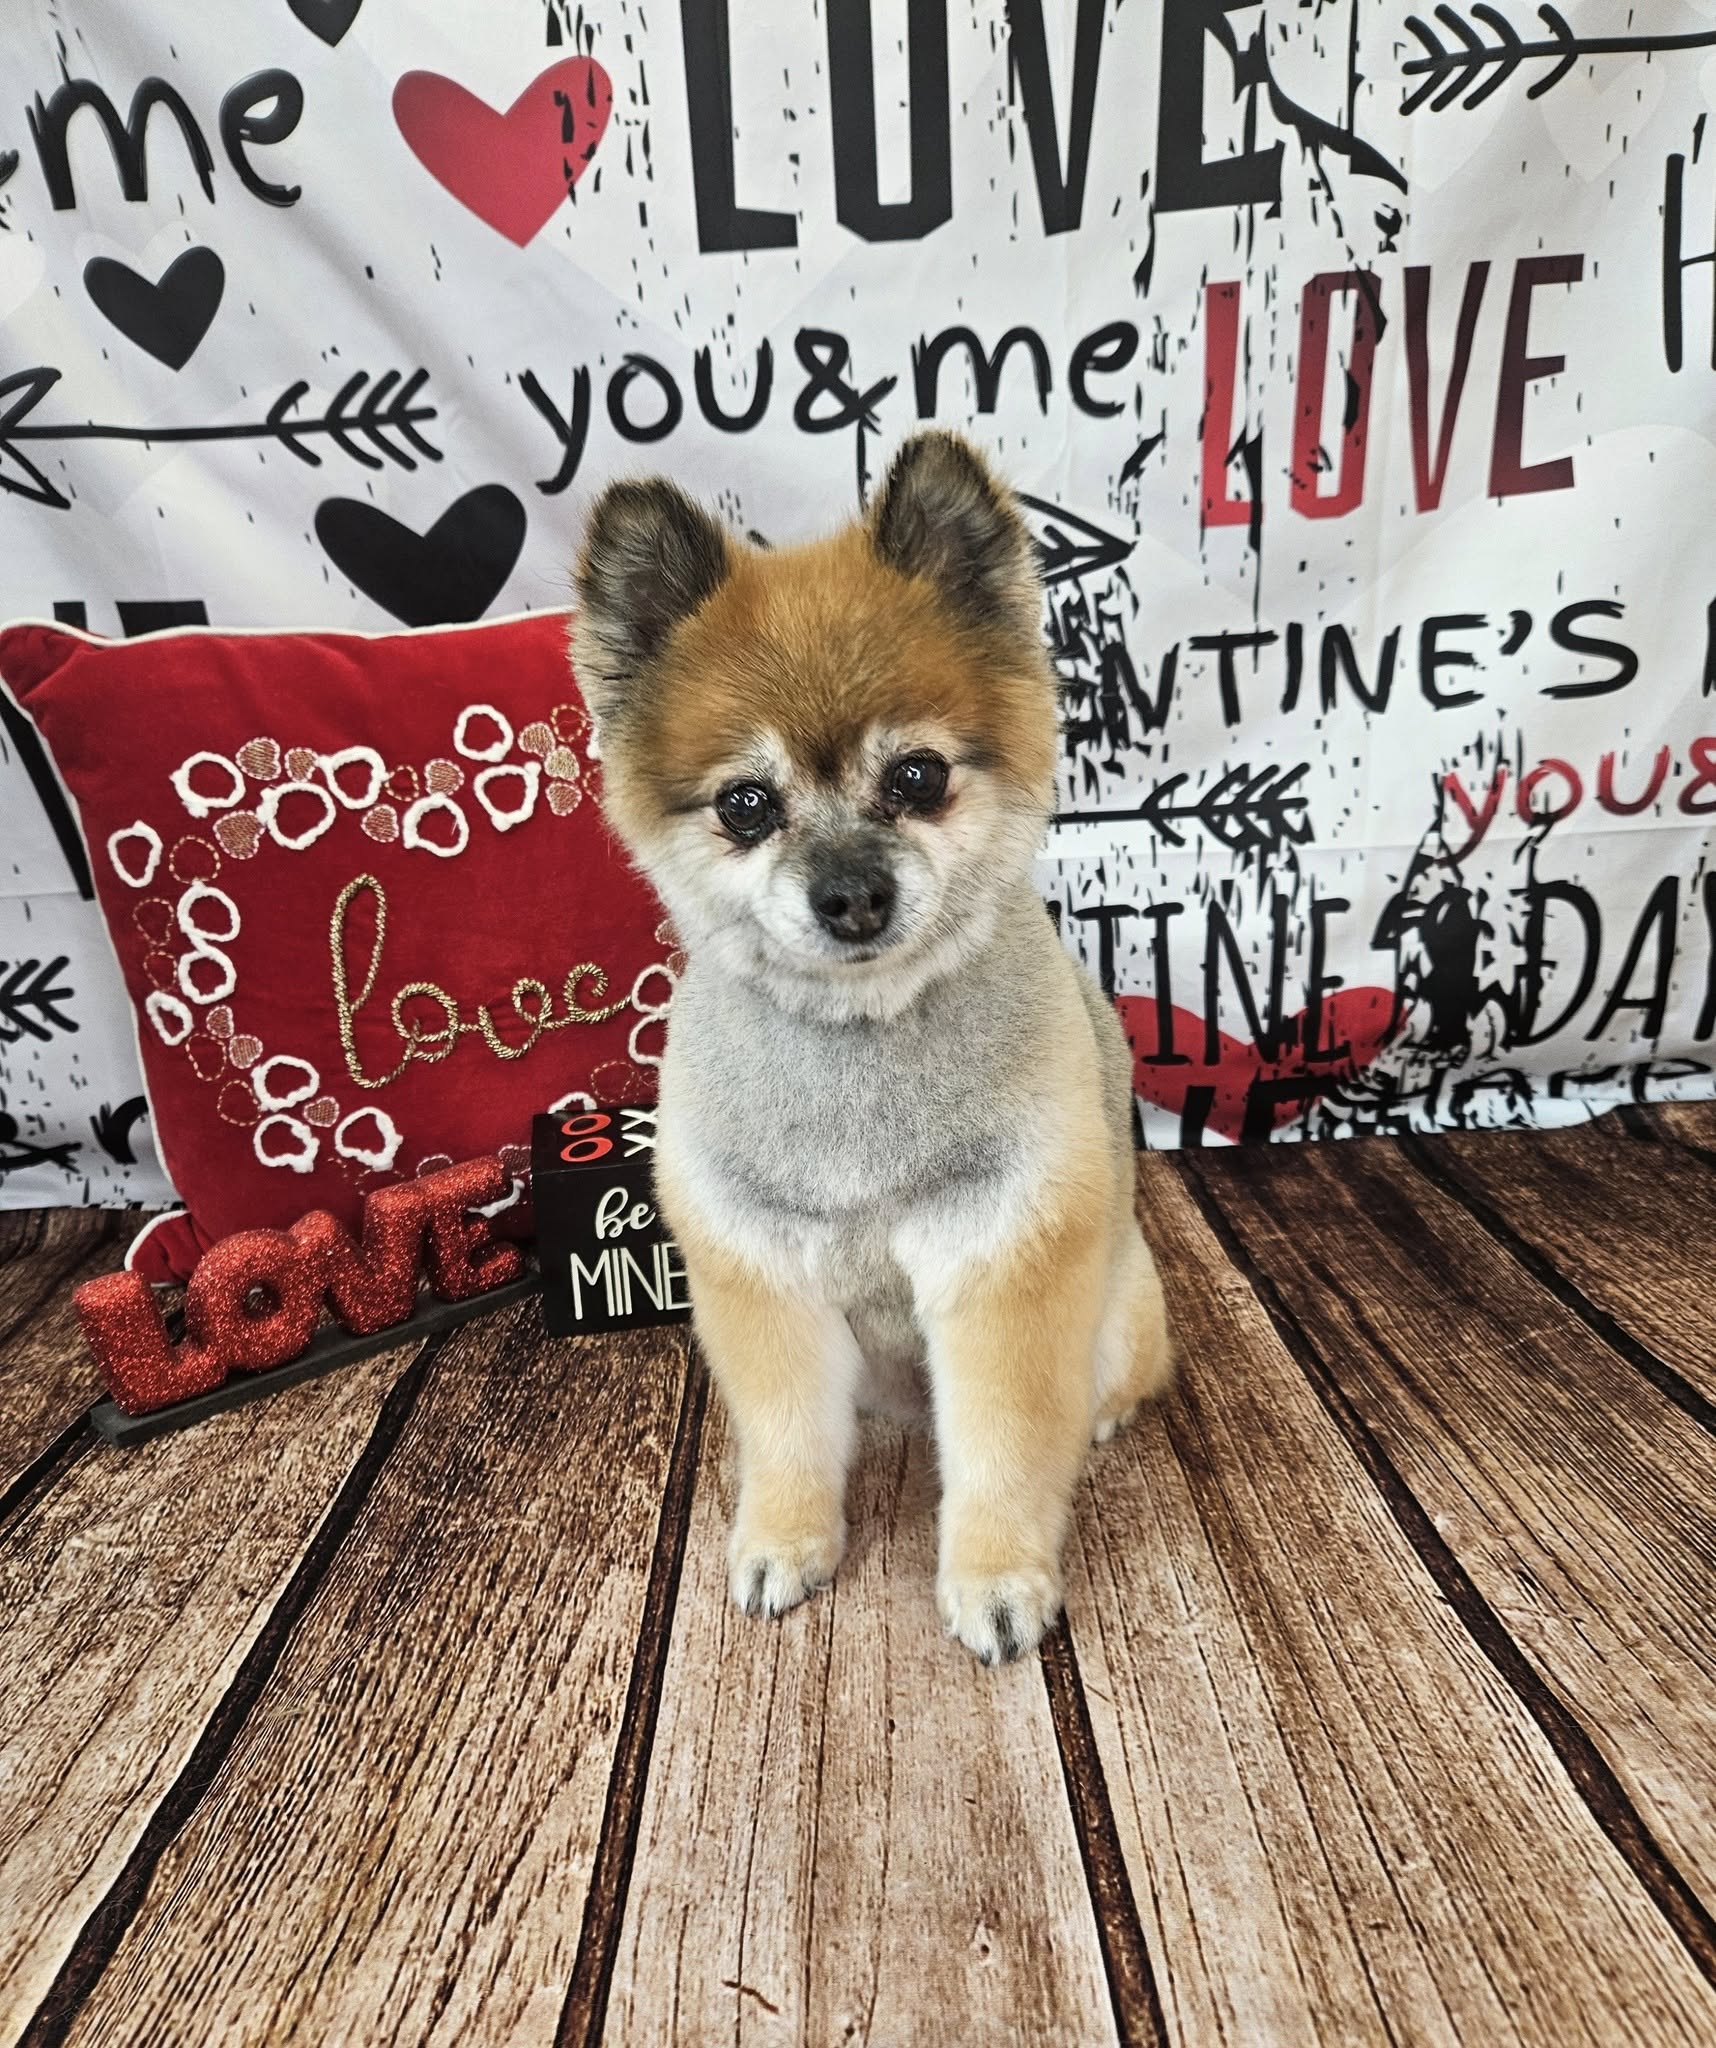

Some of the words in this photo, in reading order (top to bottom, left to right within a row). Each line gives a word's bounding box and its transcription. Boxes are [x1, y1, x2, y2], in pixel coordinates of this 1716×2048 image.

[680, 0, 1283, 253] LOVE
[1203, 254, 1584, 528] LOVE
[329, 872, 634, 1088] love
[73, 1156, 525, 1416] LOVE
[570, 1242, 694, 1321] MINE
[595, 1186, 657, 1240] be
